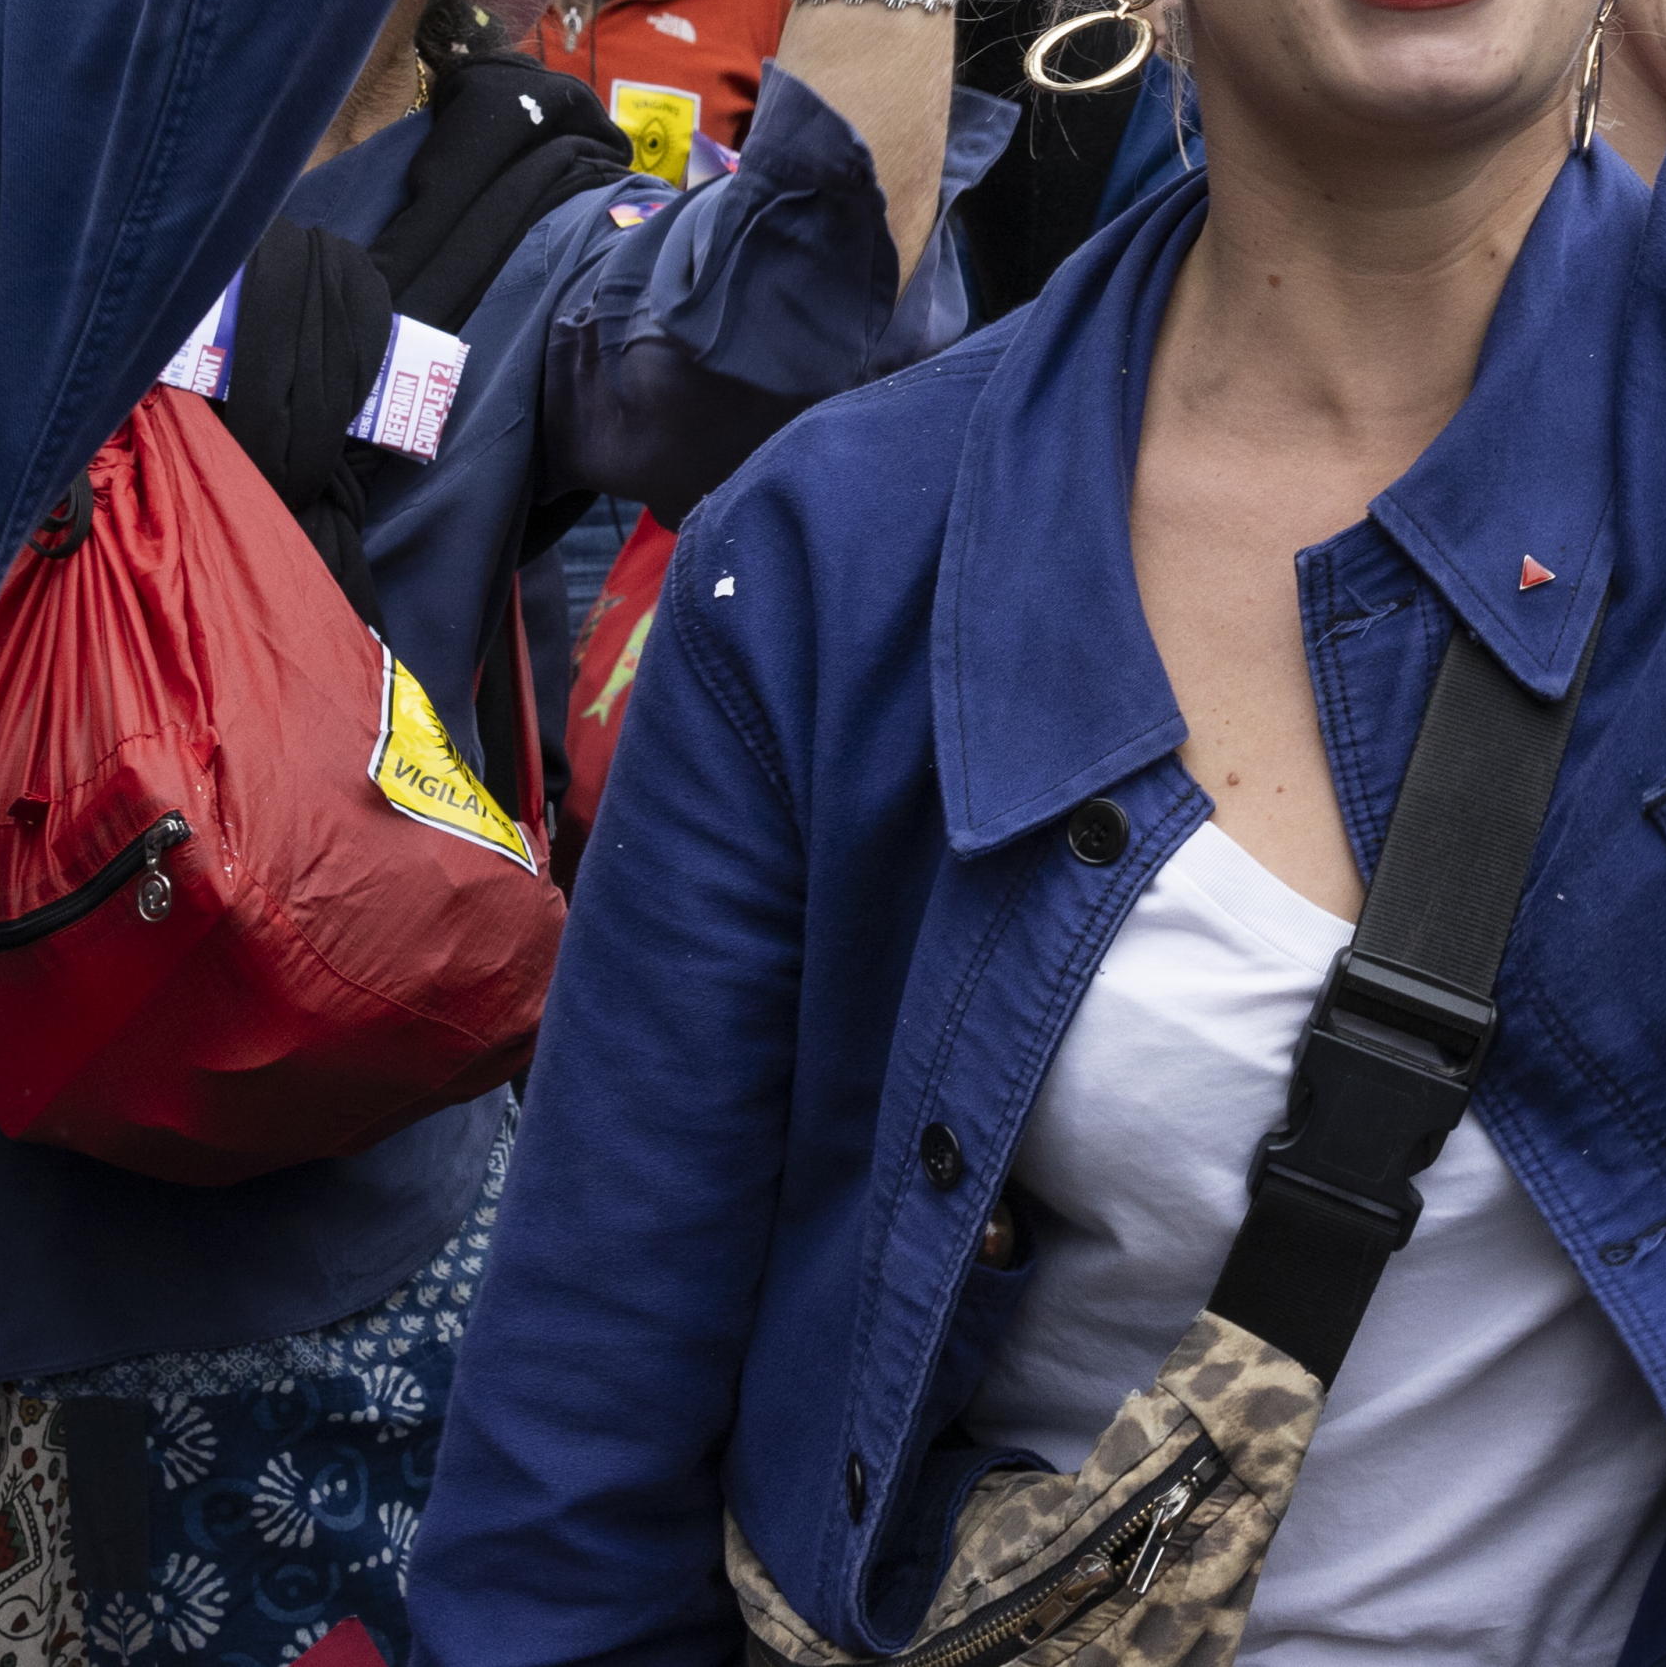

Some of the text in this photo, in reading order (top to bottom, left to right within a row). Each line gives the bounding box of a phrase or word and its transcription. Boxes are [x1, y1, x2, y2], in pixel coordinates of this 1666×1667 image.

[191, 349, 223, 398] PONT
[383, 374, 418, 447] REFRAIN
[413, 363, 453, 455] COUPLET 2
[393, 756, 516, 839] VIGILAS
